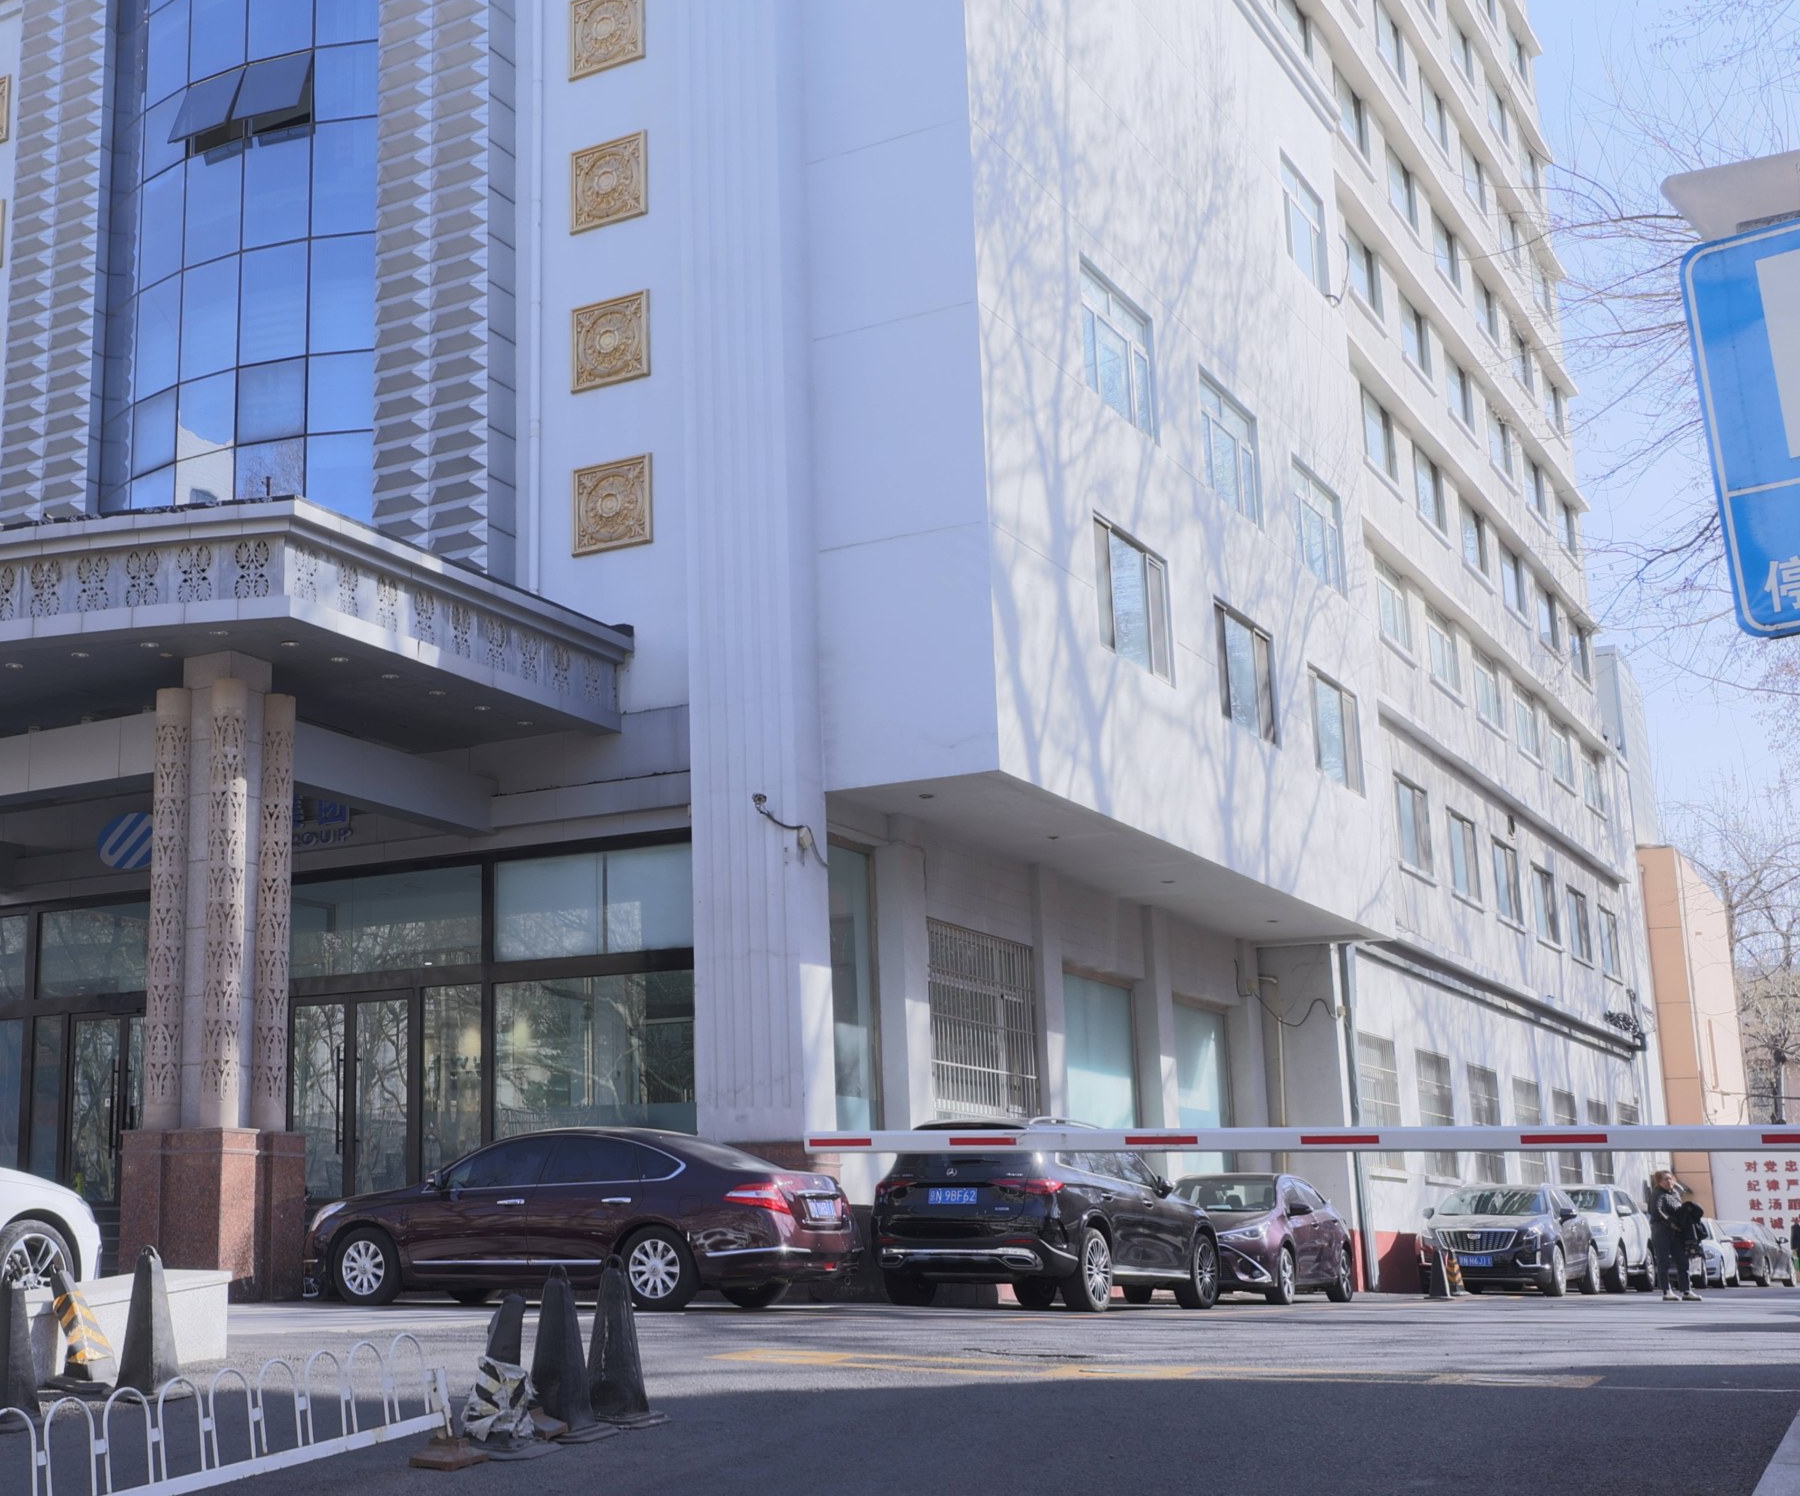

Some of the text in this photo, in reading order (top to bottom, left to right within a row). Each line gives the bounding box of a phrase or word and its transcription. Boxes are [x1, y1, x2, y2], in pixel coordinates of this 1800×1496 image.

[1744, 1160, 1799, 1173] 对党忠
[1747, 1179, 1800, 1192] 纪律严
